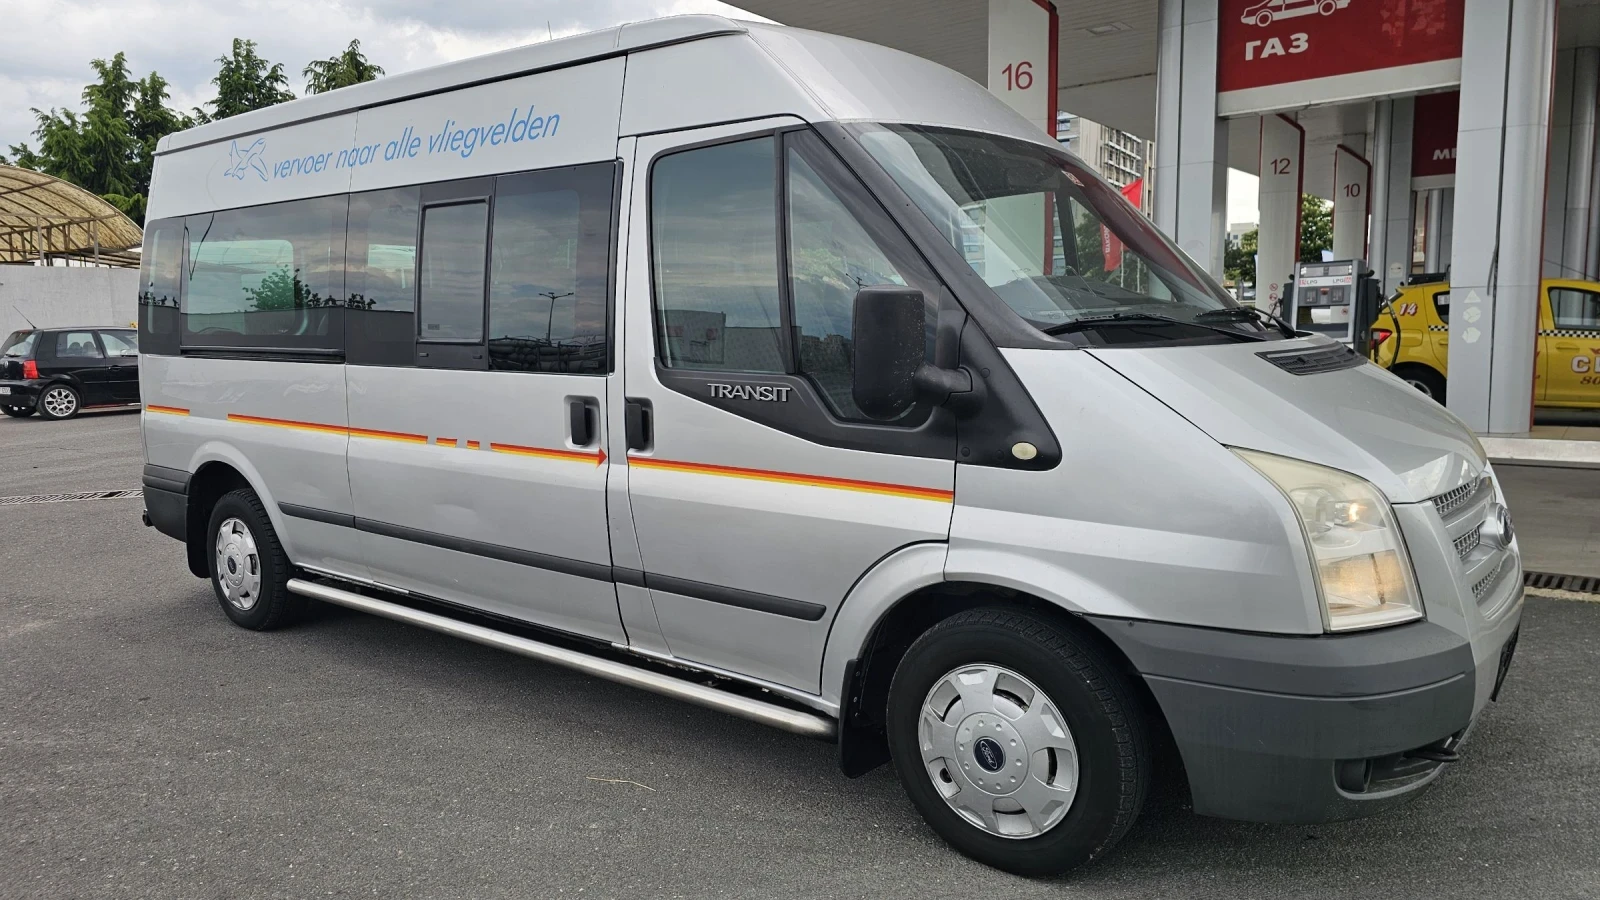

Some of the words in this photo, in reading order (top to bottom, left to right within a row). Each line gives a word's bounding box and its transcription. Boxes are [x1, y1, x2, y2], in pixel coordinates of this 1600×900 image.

[1245, 32, 1309, 61] ГАЗ
[1001, 61, 1033, 91] 16
[273, 151, 333, 179] vervoer
[335, 143, 381, 169] naar
[384, 126, 421, 161] alle
[429, 104, 560, 158] vliegvelden
[1270, 157, 1291, 175] 12
[1343, 183, 1361, 198] 10
[1399, 302, 1418, 317] 14
[707, 383, 791, 402] TRANSIT
